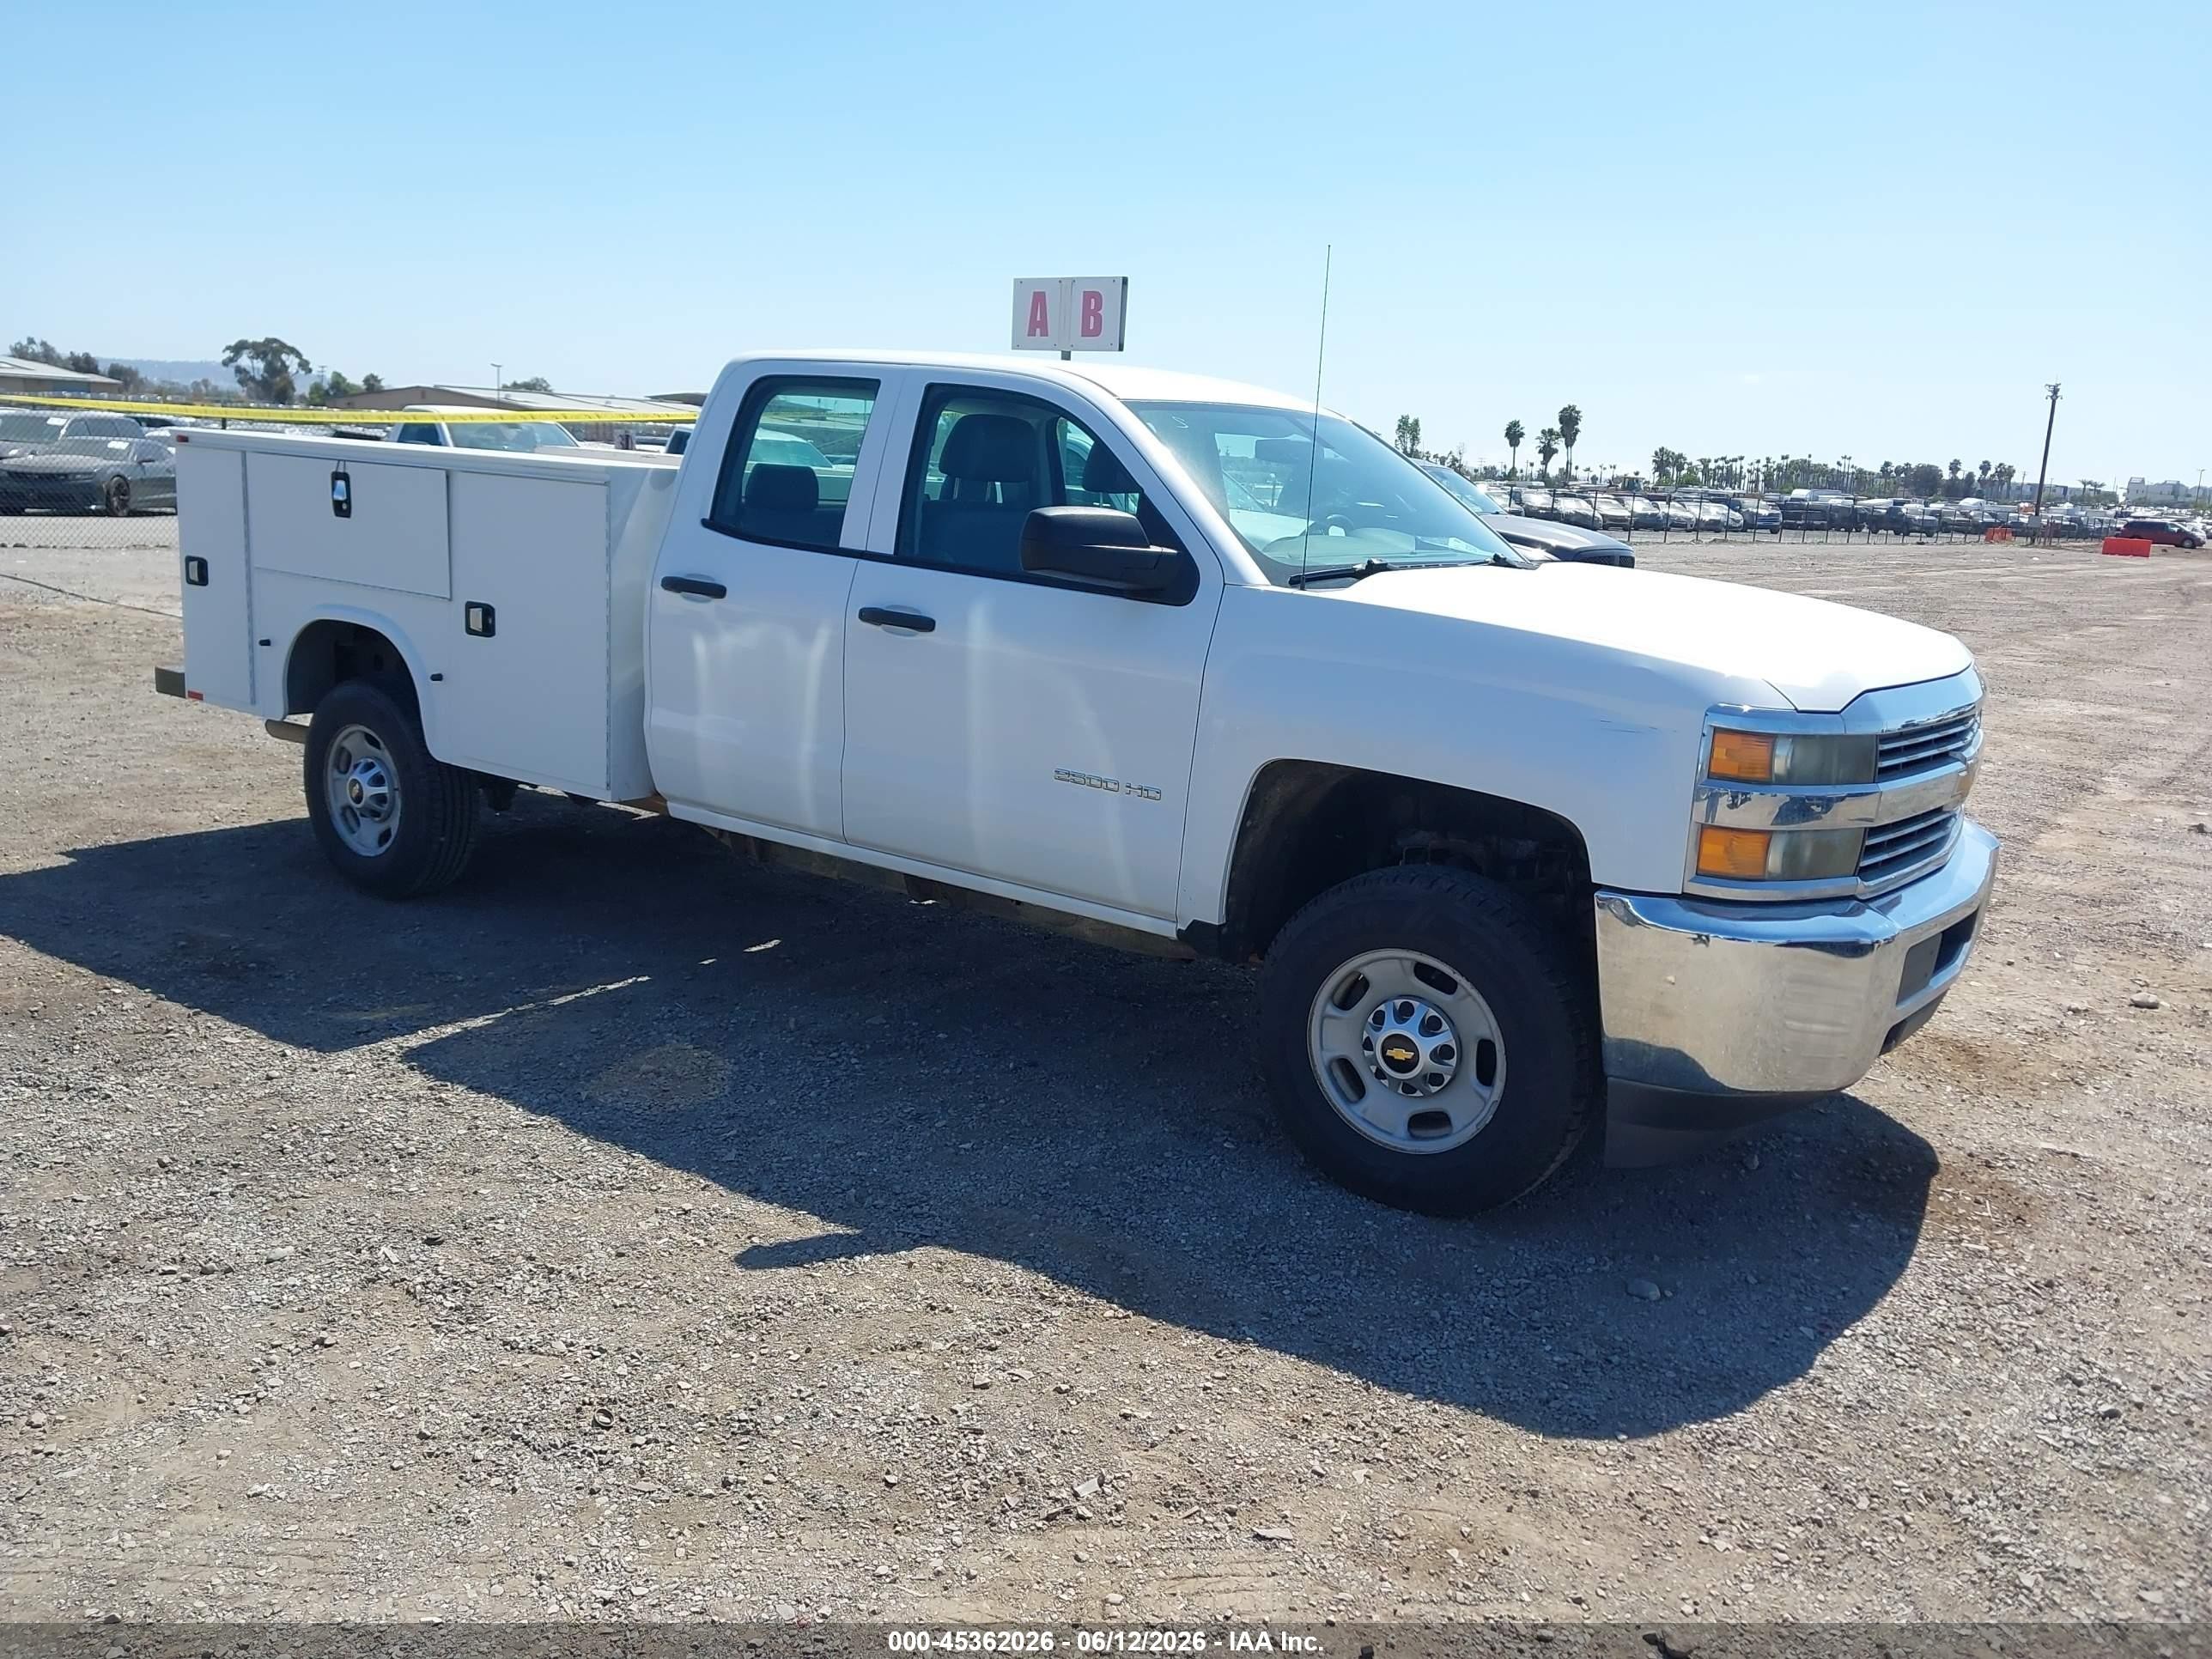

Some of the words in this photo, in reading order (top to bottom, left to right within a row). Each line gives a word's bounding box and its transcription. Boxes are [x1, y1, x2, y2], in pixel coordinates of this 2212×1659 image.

[1027, 291, 1048, 337] A
[1081, 290, 1103, 337] B
[1054, 768, 1120, 793] 2500
[1125, 782, 1162, 801] HD
